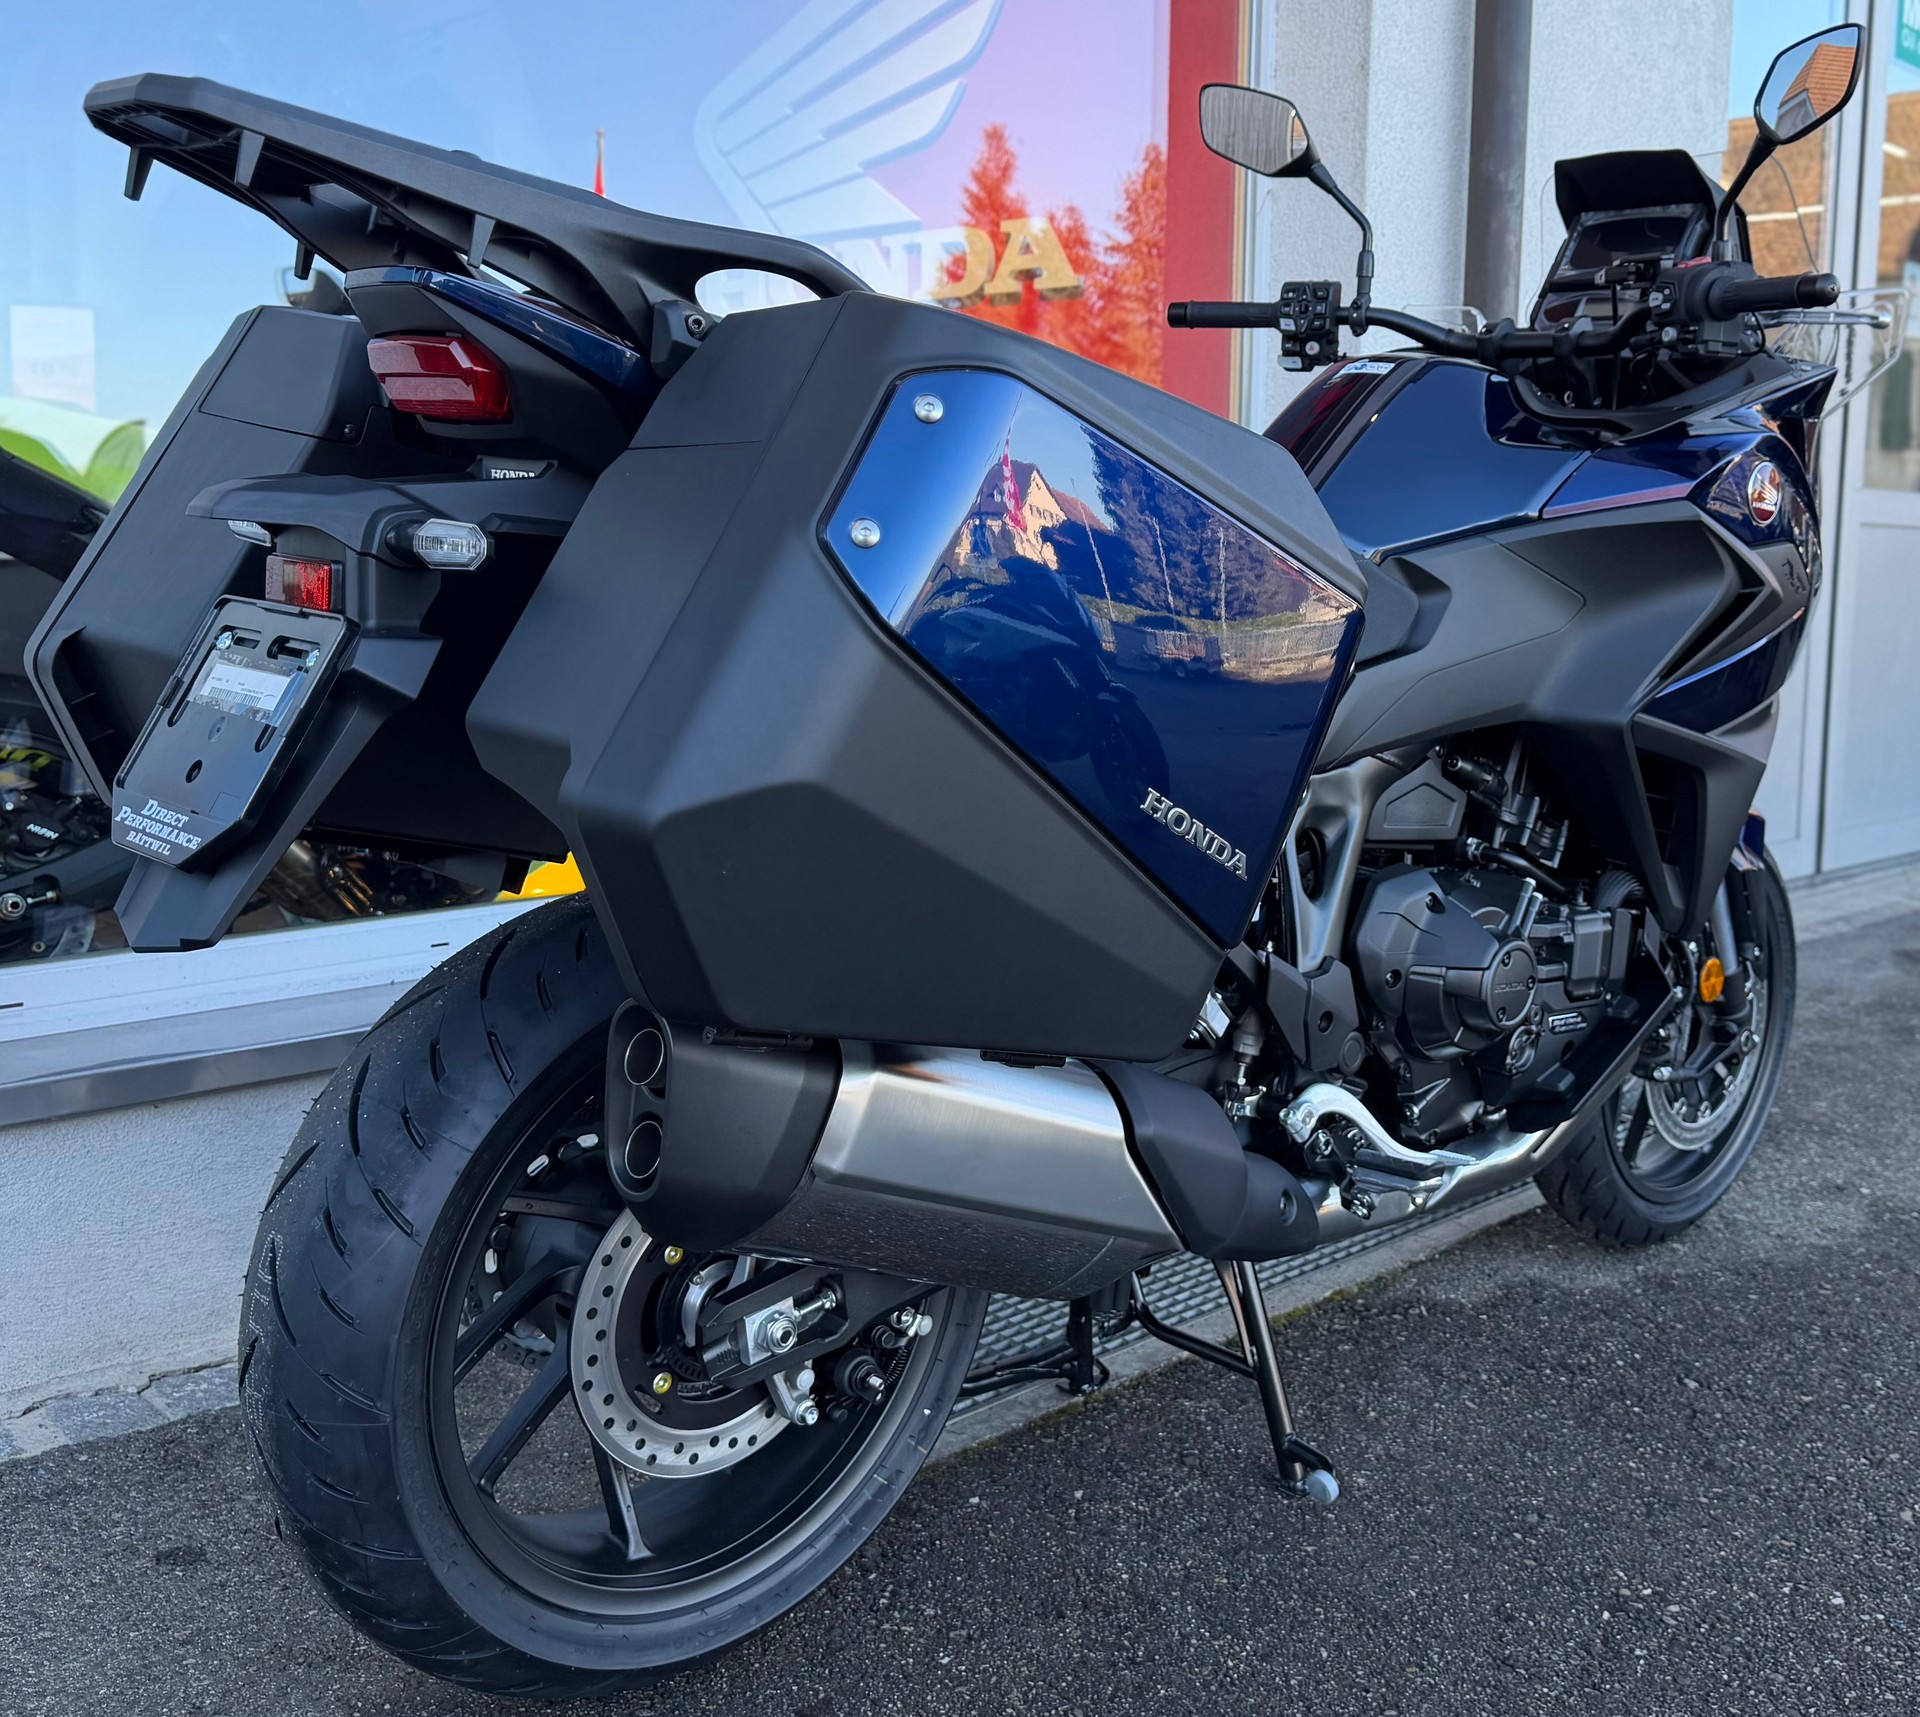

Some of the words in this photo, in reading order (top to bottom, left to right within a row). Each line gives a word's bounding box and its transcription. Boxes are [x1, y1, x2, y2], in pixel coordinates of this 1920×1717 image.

[114, 805, 202, 850] PERFORMANCE
[140, 798, 190, 828] DIRECT
[1140, 787, 1248, 881] HONDA
